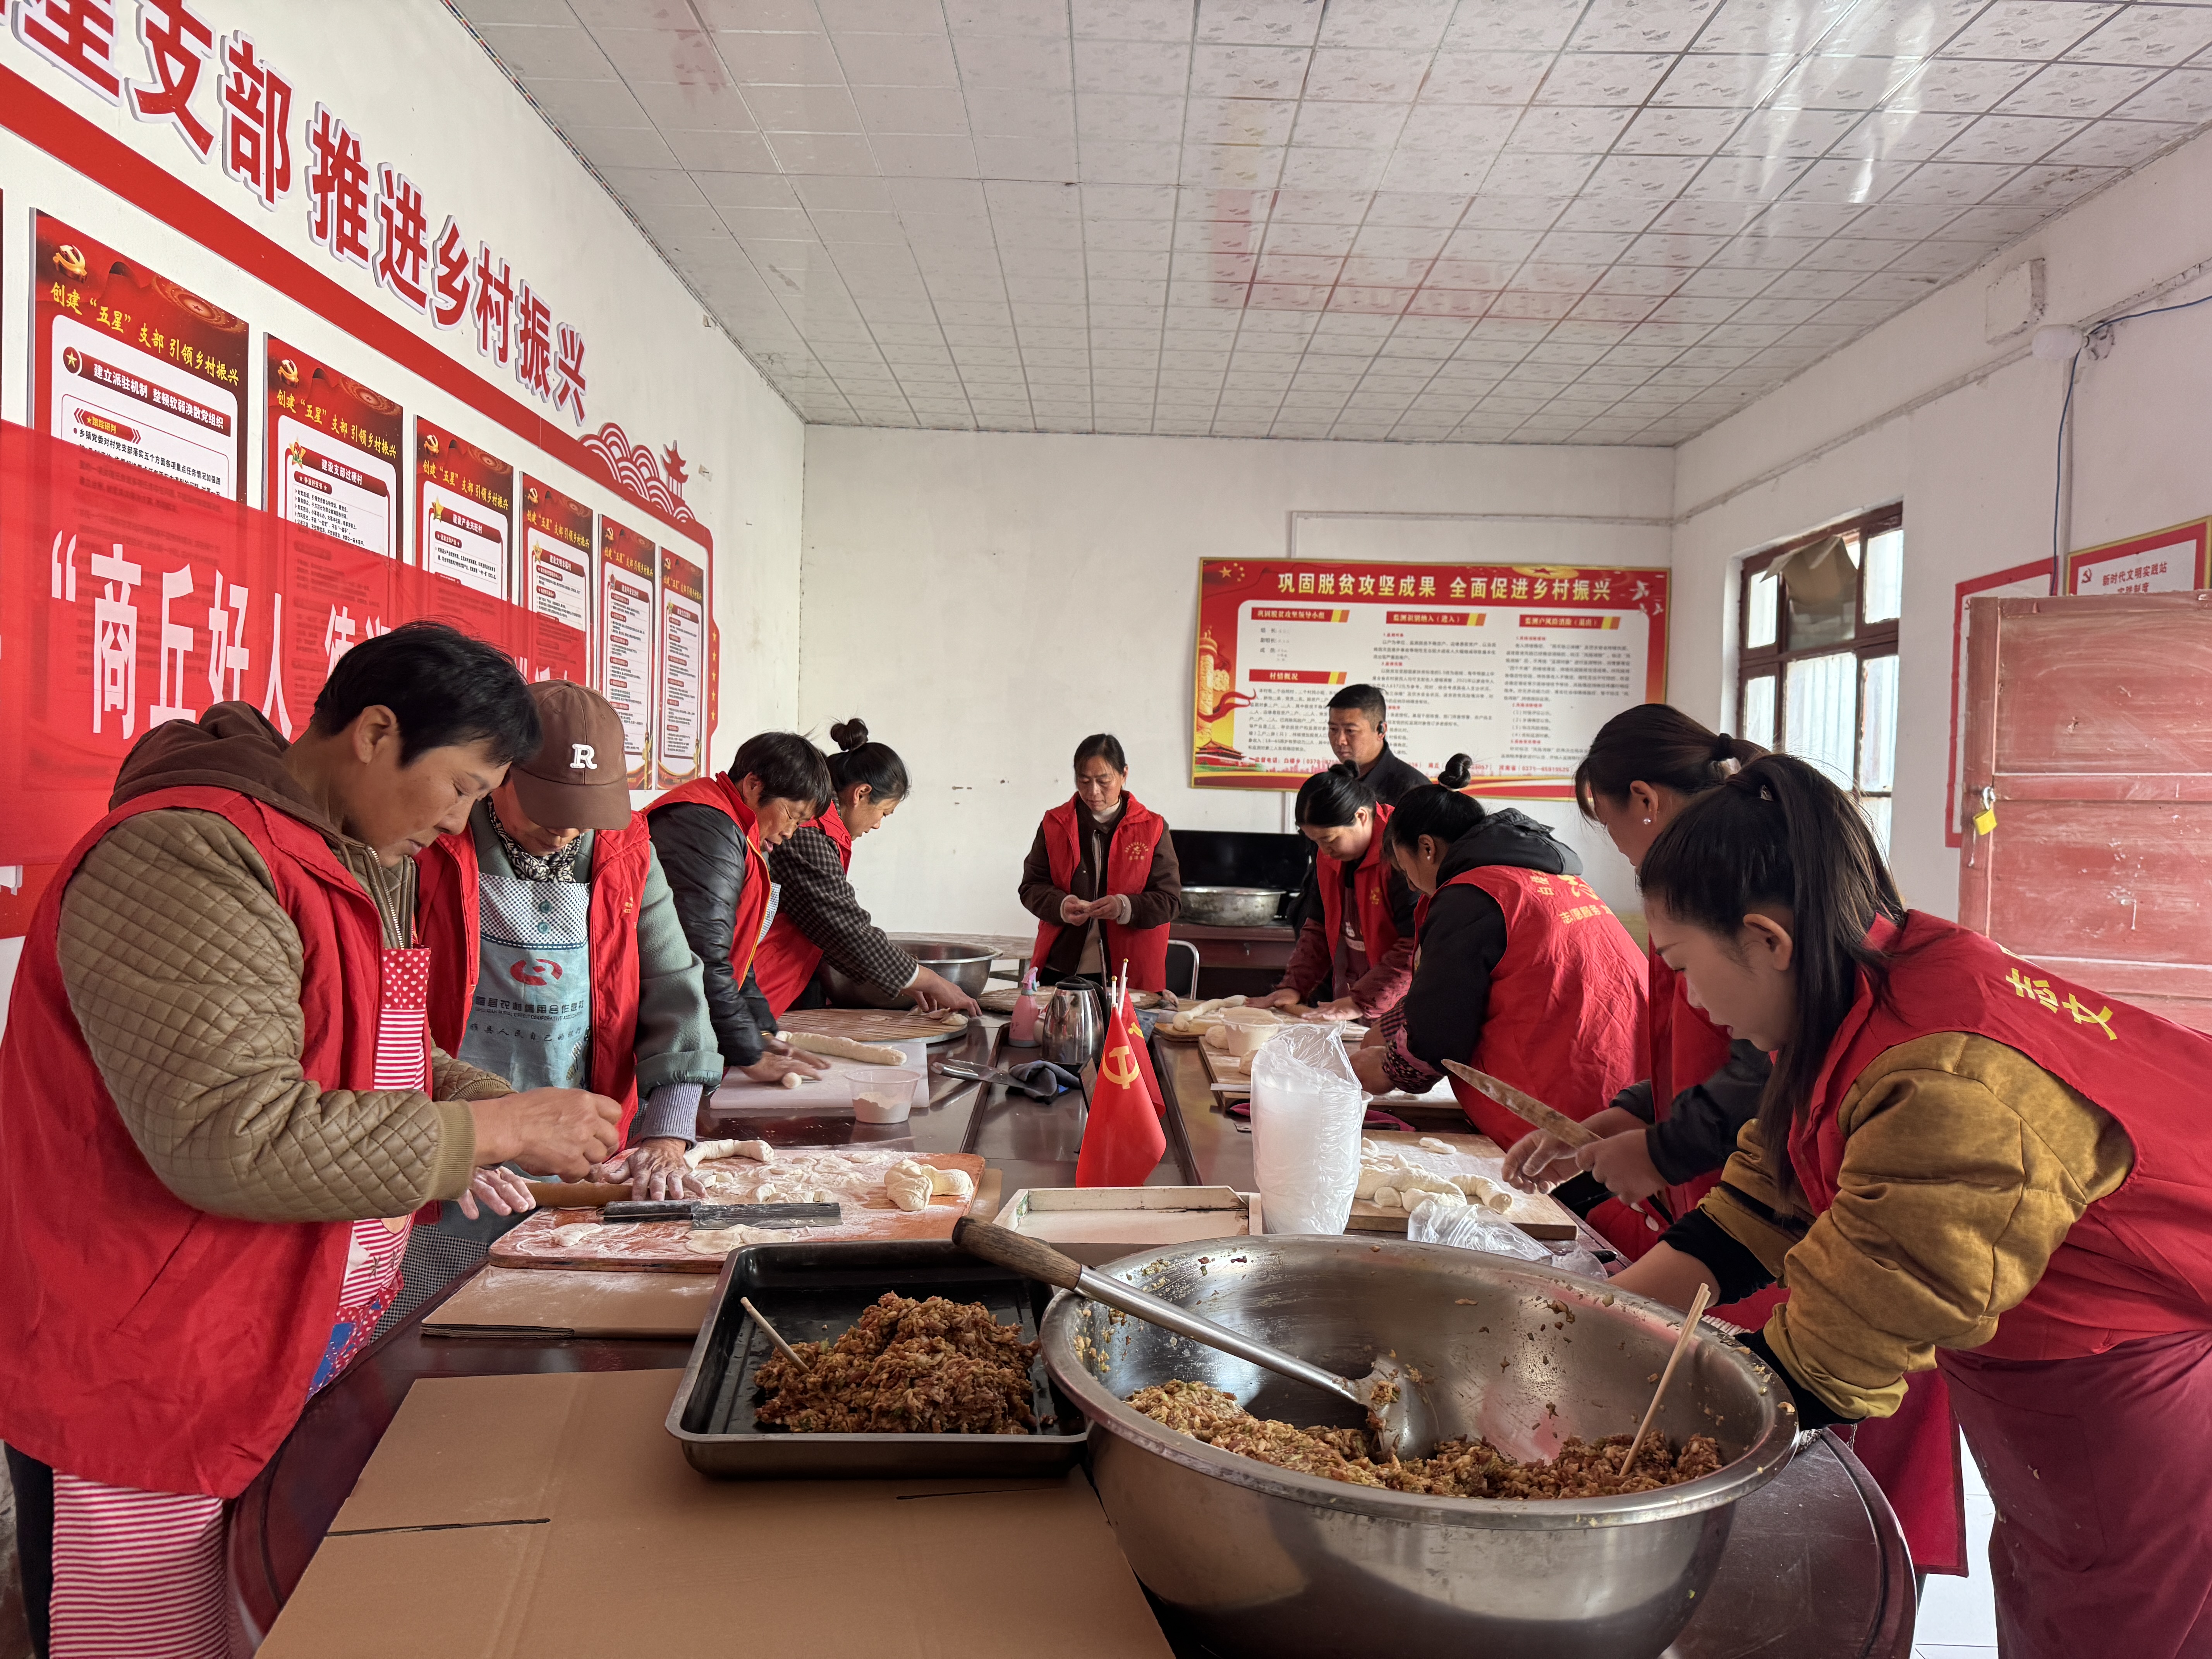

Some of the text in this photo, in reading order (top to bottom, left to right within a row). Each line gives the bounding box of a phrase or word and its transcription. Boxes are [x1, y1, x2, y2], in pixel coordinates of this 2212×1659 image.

[308, 105, 589, 423] 推进乡村振兴
[1277, 572, 1611, 601] 巩固脱贫攻坚成果 全面促进乡村振兴
[2102, 562, 2167, 587] 新时代文明实践站
[1269, 672, 1298, 681] 村情概况
[570, 743, 598, 770] R
